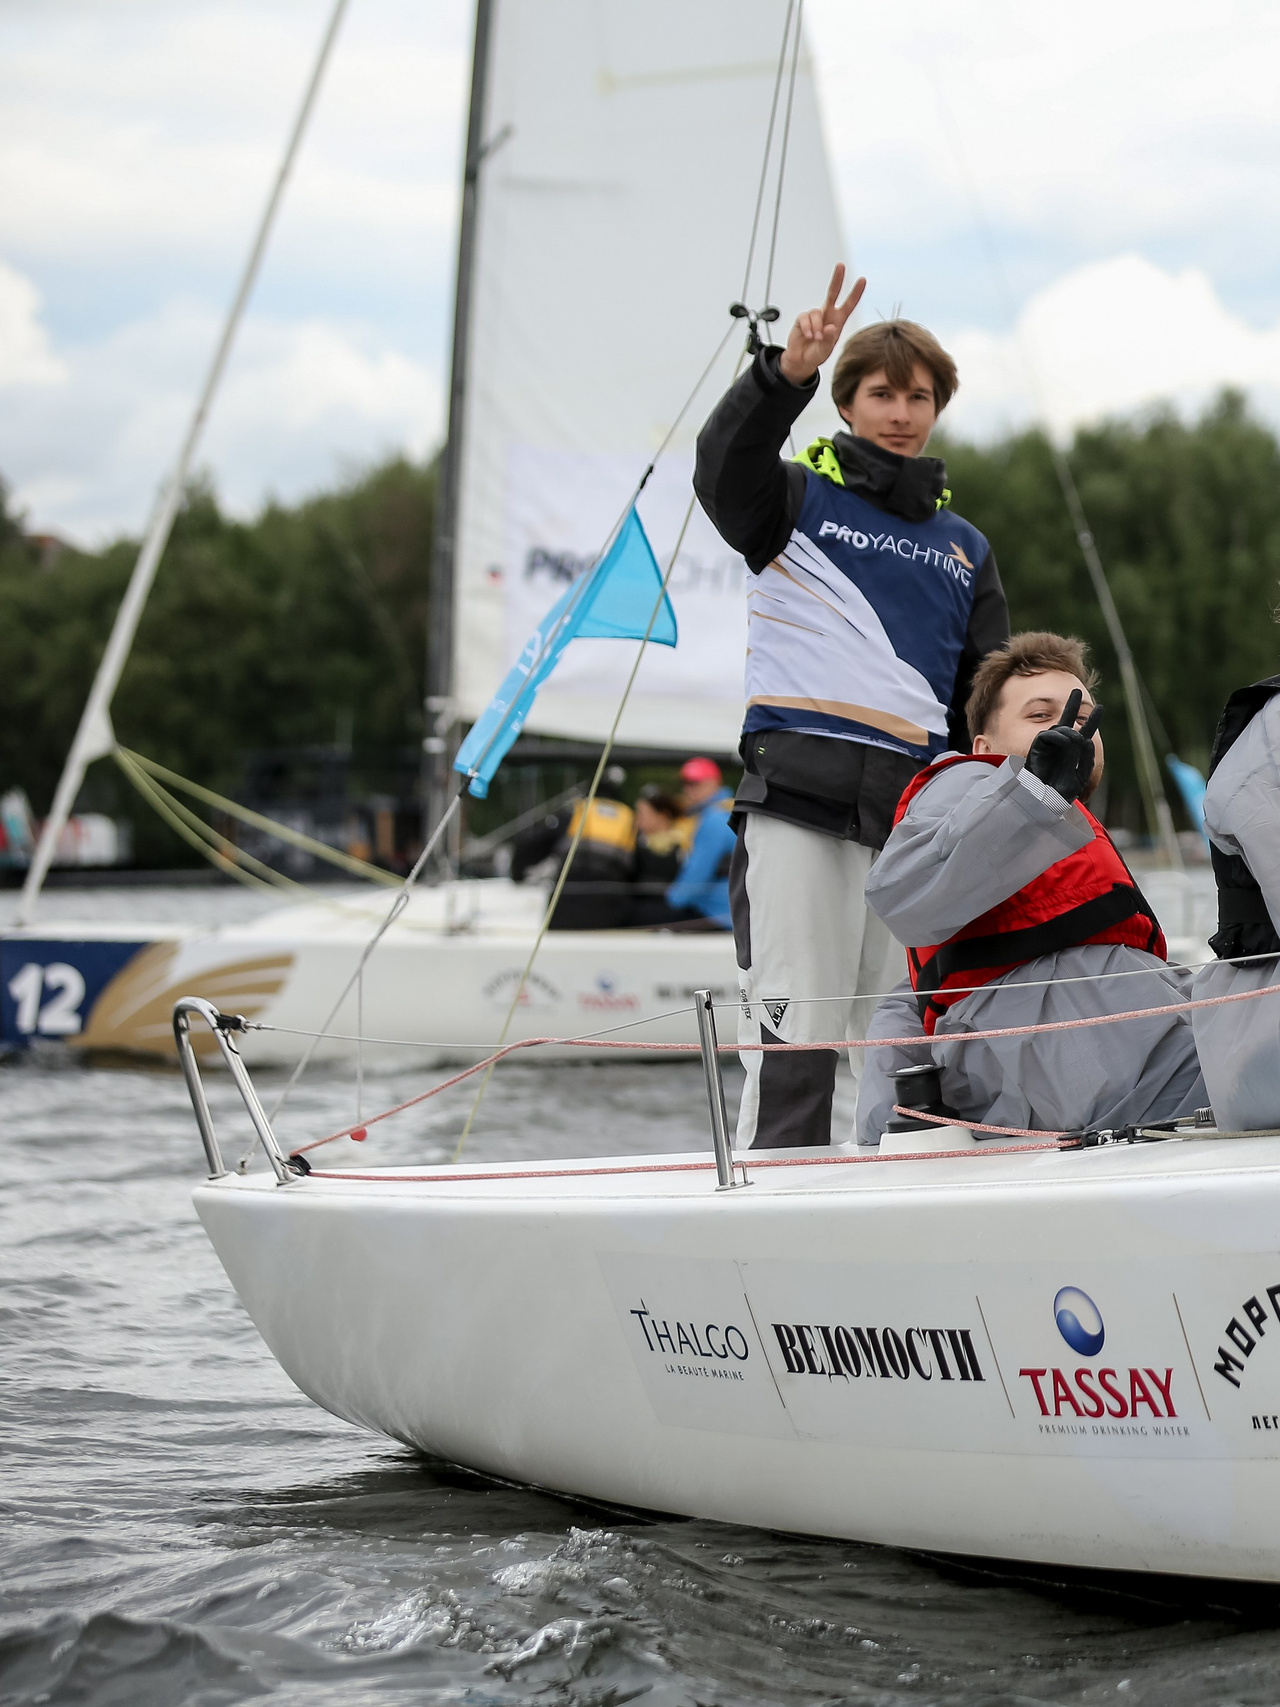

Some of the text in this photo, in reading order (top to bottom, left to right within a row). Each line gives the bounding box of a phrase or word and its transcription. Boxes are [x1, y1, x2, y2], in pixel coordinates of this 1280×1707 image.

[818, 520, 972, 588] PROYACHTING
[8, 961, 86, 1035] 12
[740, 989, 752, 1019] GORTEX
[630, 1298, 749, 1361] THALGO
[771, 1323, 986, 1384] ВЕДОМОСТИ
[664, 1363, 676, 1374] LA
[711, 1368, 745, 1381] MARINE
[1018, 1367, 1179, 1419] TASSAY
[1038, 1424, 1191, 1436] PREMIUM DRINKING WATER
